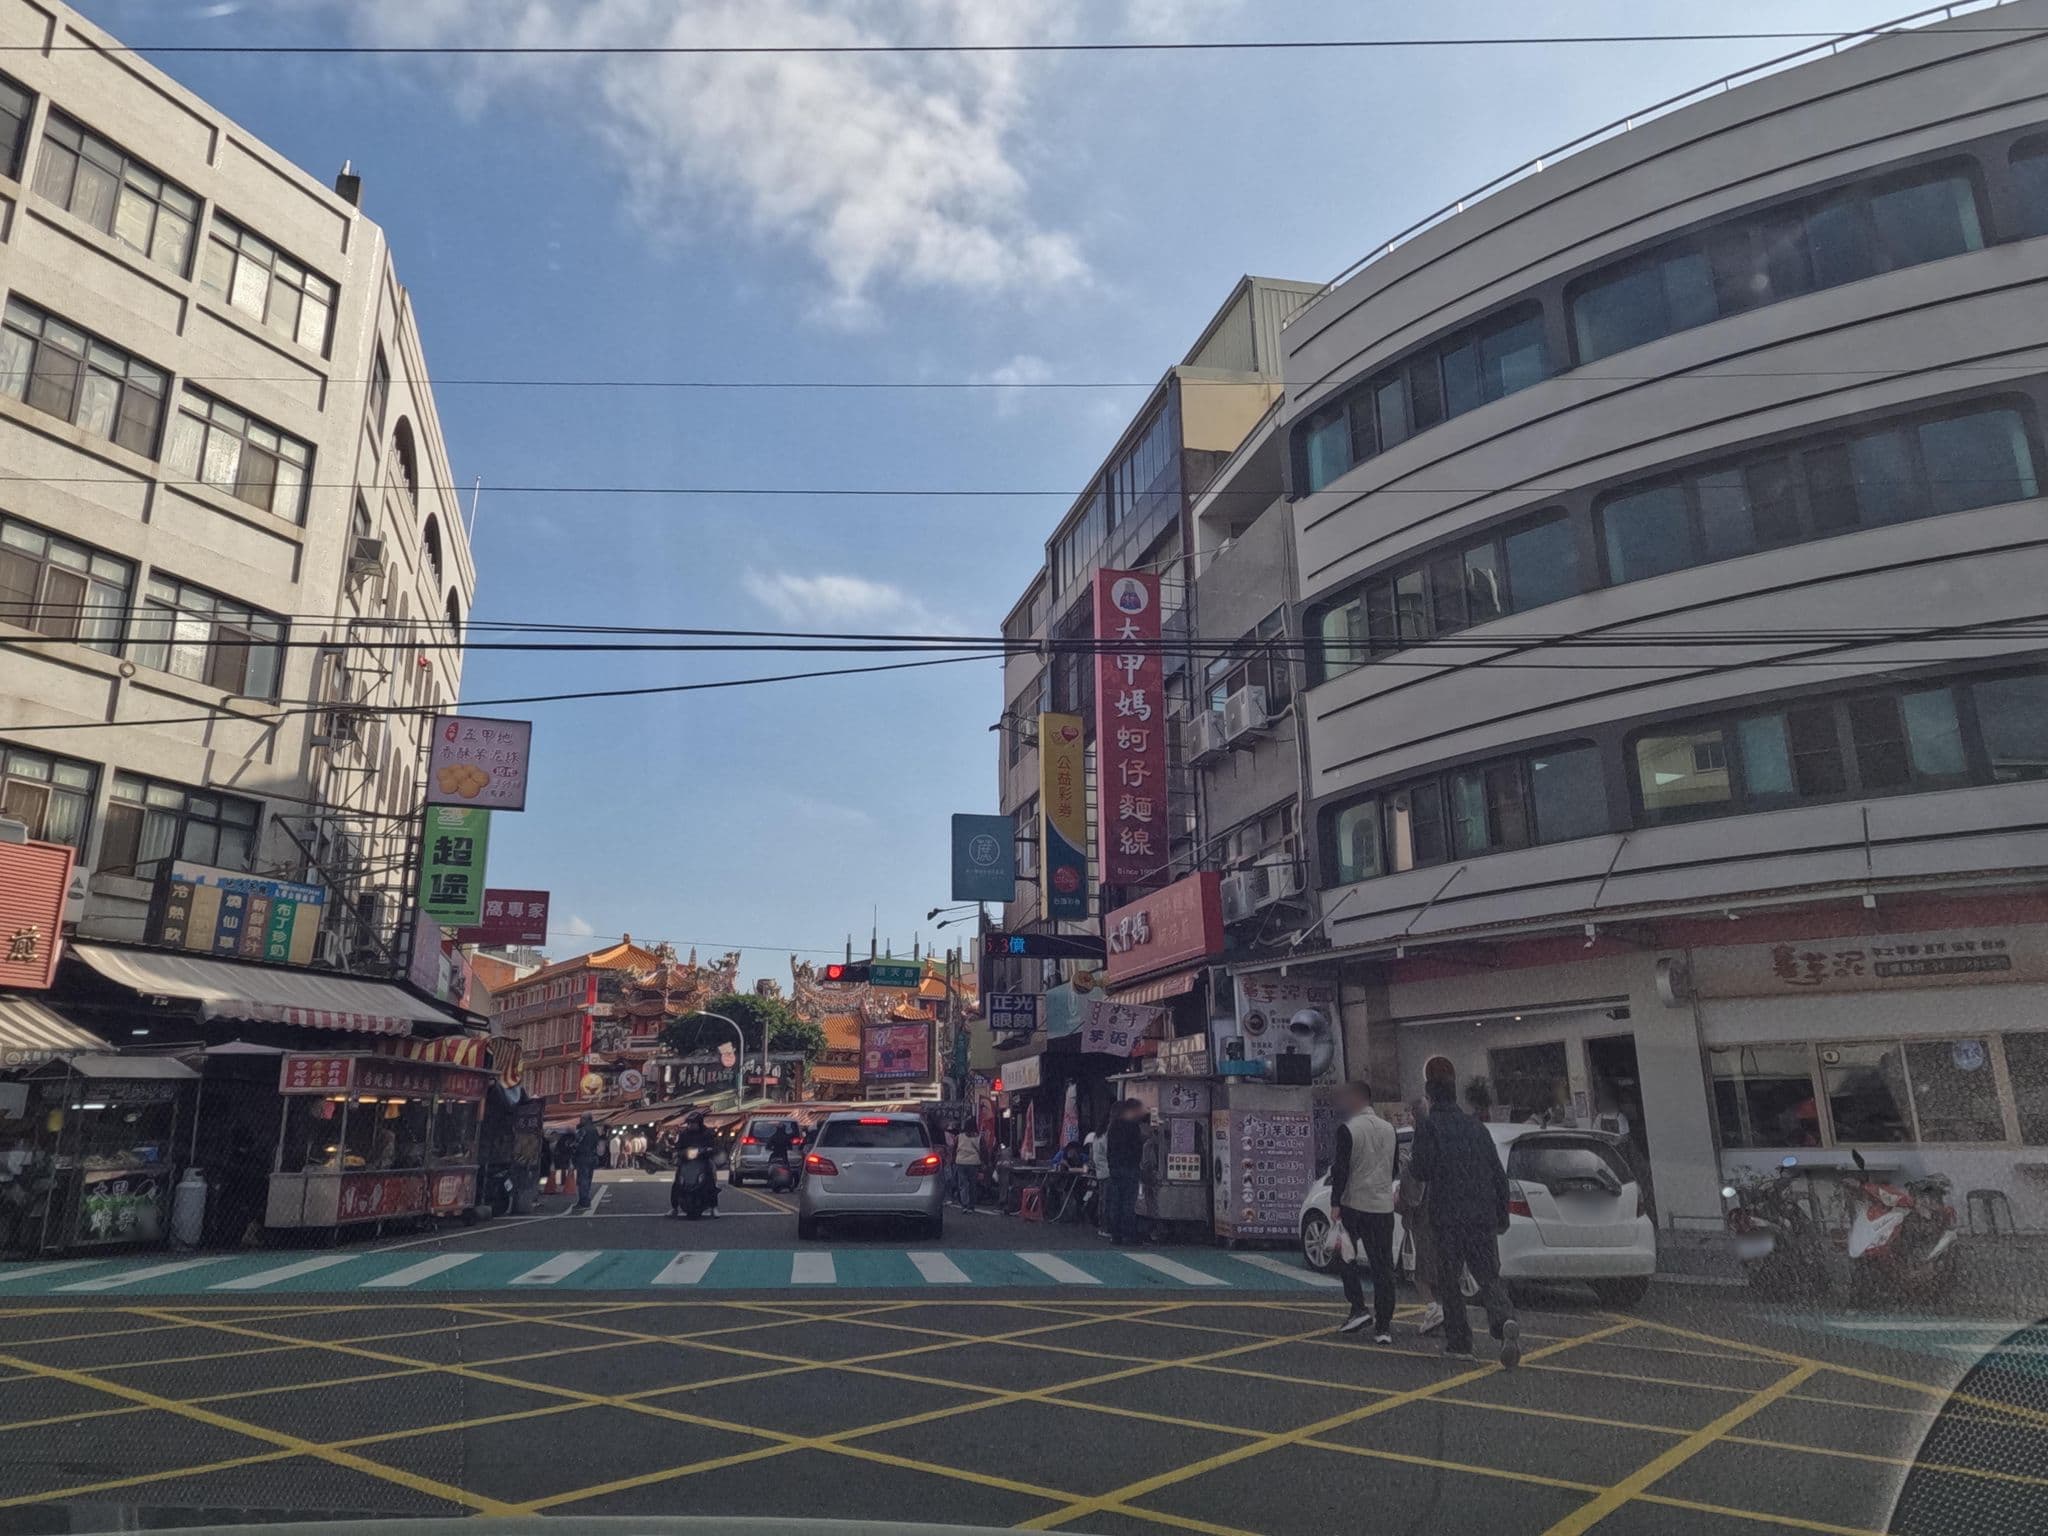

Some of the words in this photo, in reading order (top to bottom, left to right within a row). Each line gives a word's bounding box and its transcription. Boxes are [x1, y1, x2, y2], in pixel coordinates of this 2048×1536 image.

[1114, 617, 1154, 856] 大甲媽蚵仔麵線
[992, 996, 1033, 1010] 正光
[992, 1013, 1033, 1028] 眼鏡
